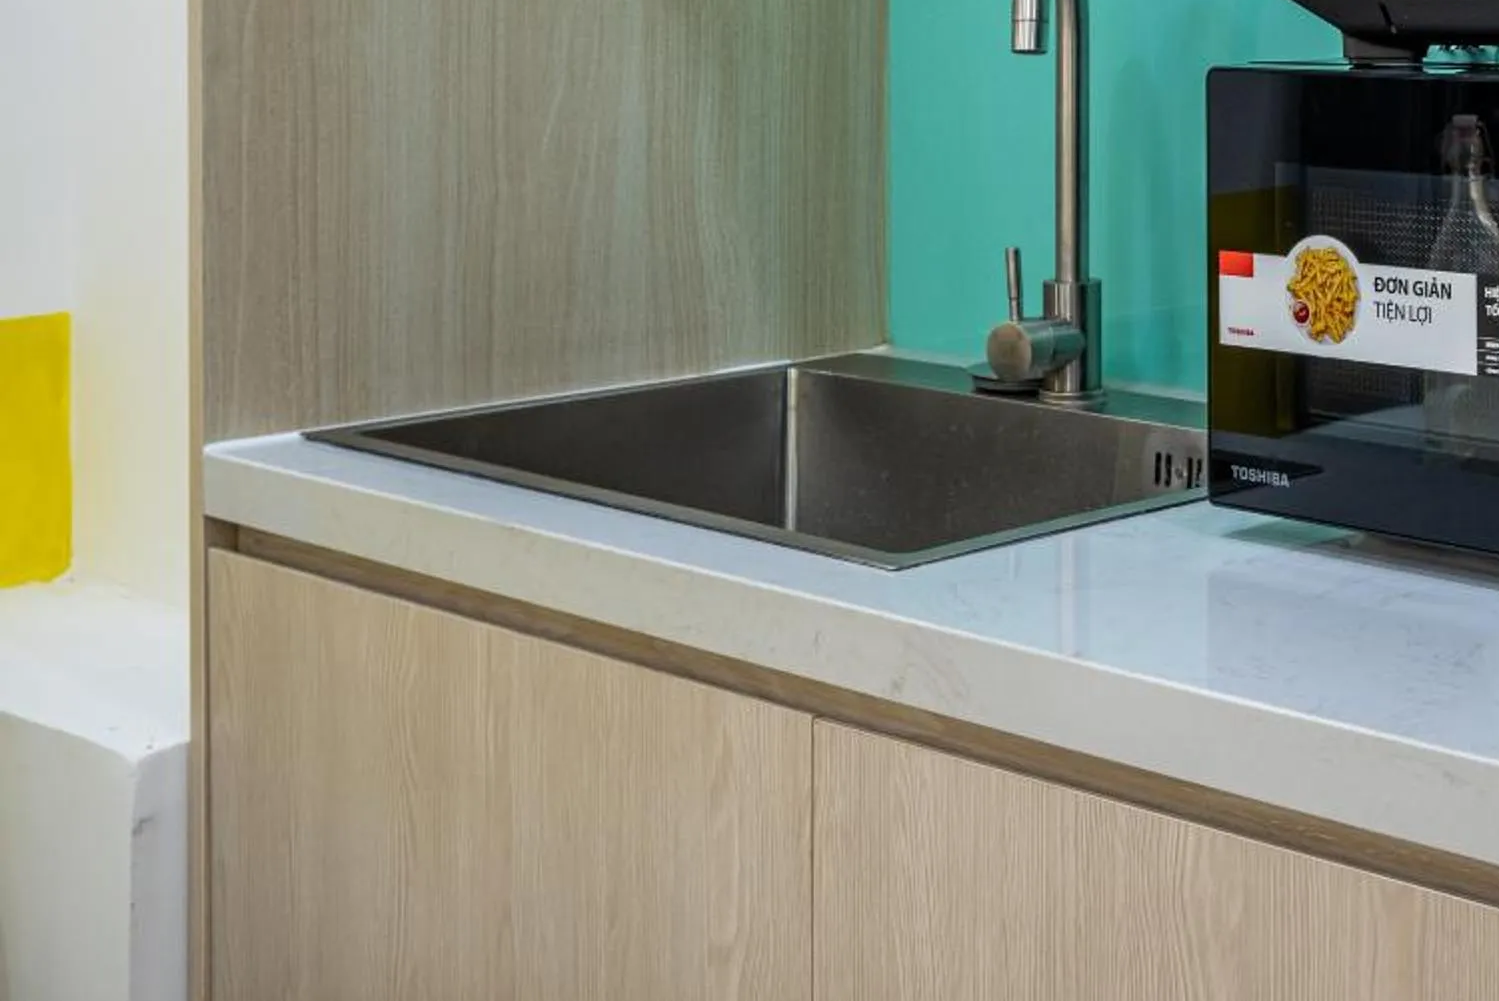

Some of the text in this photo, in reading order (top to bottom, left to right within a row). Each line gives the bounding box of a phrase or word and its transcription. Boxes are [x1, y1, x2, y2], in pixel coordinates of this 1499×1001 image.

[1374, 275, 1452, 300] ĐƠN GIẢN
[1375, 301, 1432, 325] TIỆN LỢI
[1230, 464, 1290, 488] TOSHIBA
